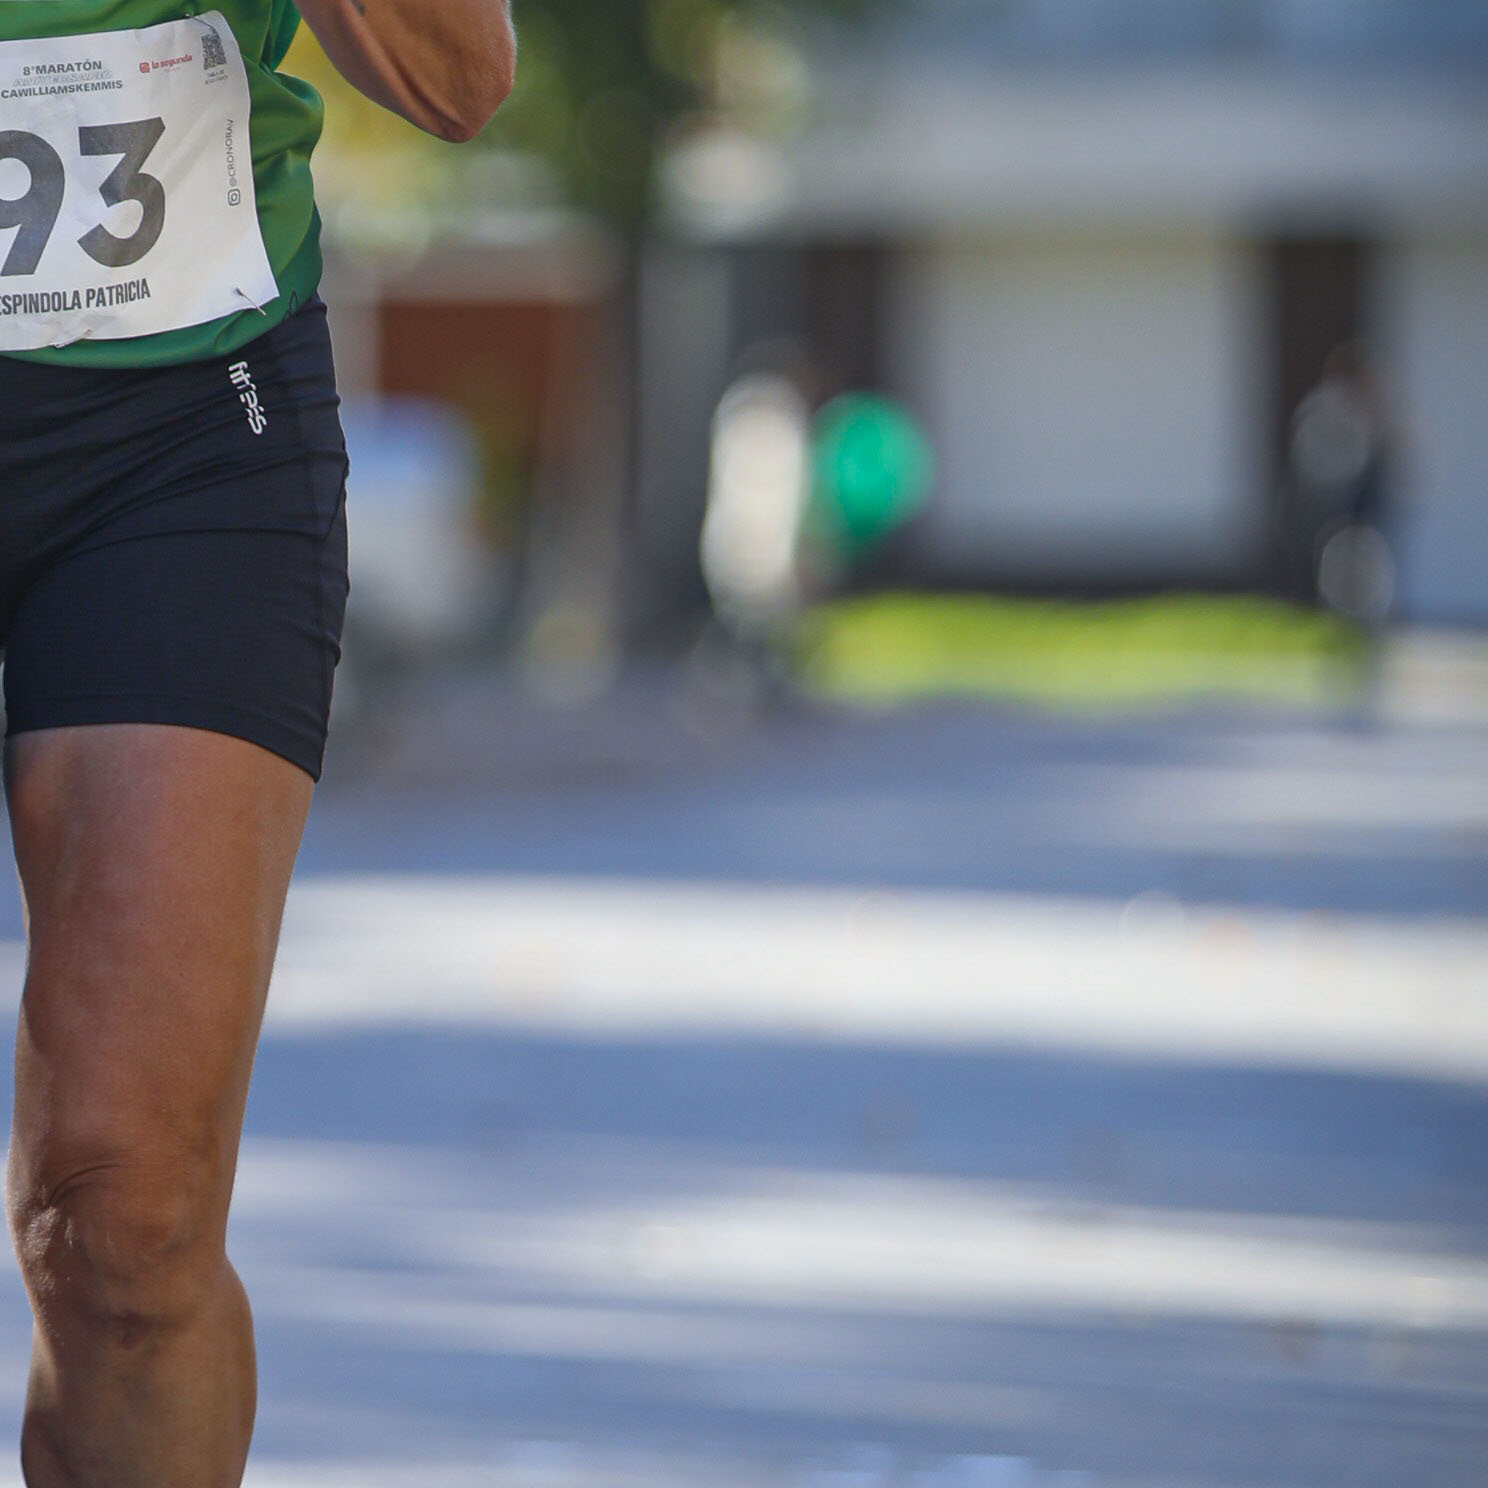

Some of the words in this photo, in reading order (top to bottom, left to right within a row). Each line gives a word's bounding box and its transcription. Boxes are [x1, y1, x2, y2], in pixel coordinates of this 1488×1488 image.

[152, 60, 160, 69] la
[160, 54, 193, 68] segunda
[1, 80, 123, 99] CAWILLIAMSKEMMIS
[86, 277, 151, 308] PATRICIA
